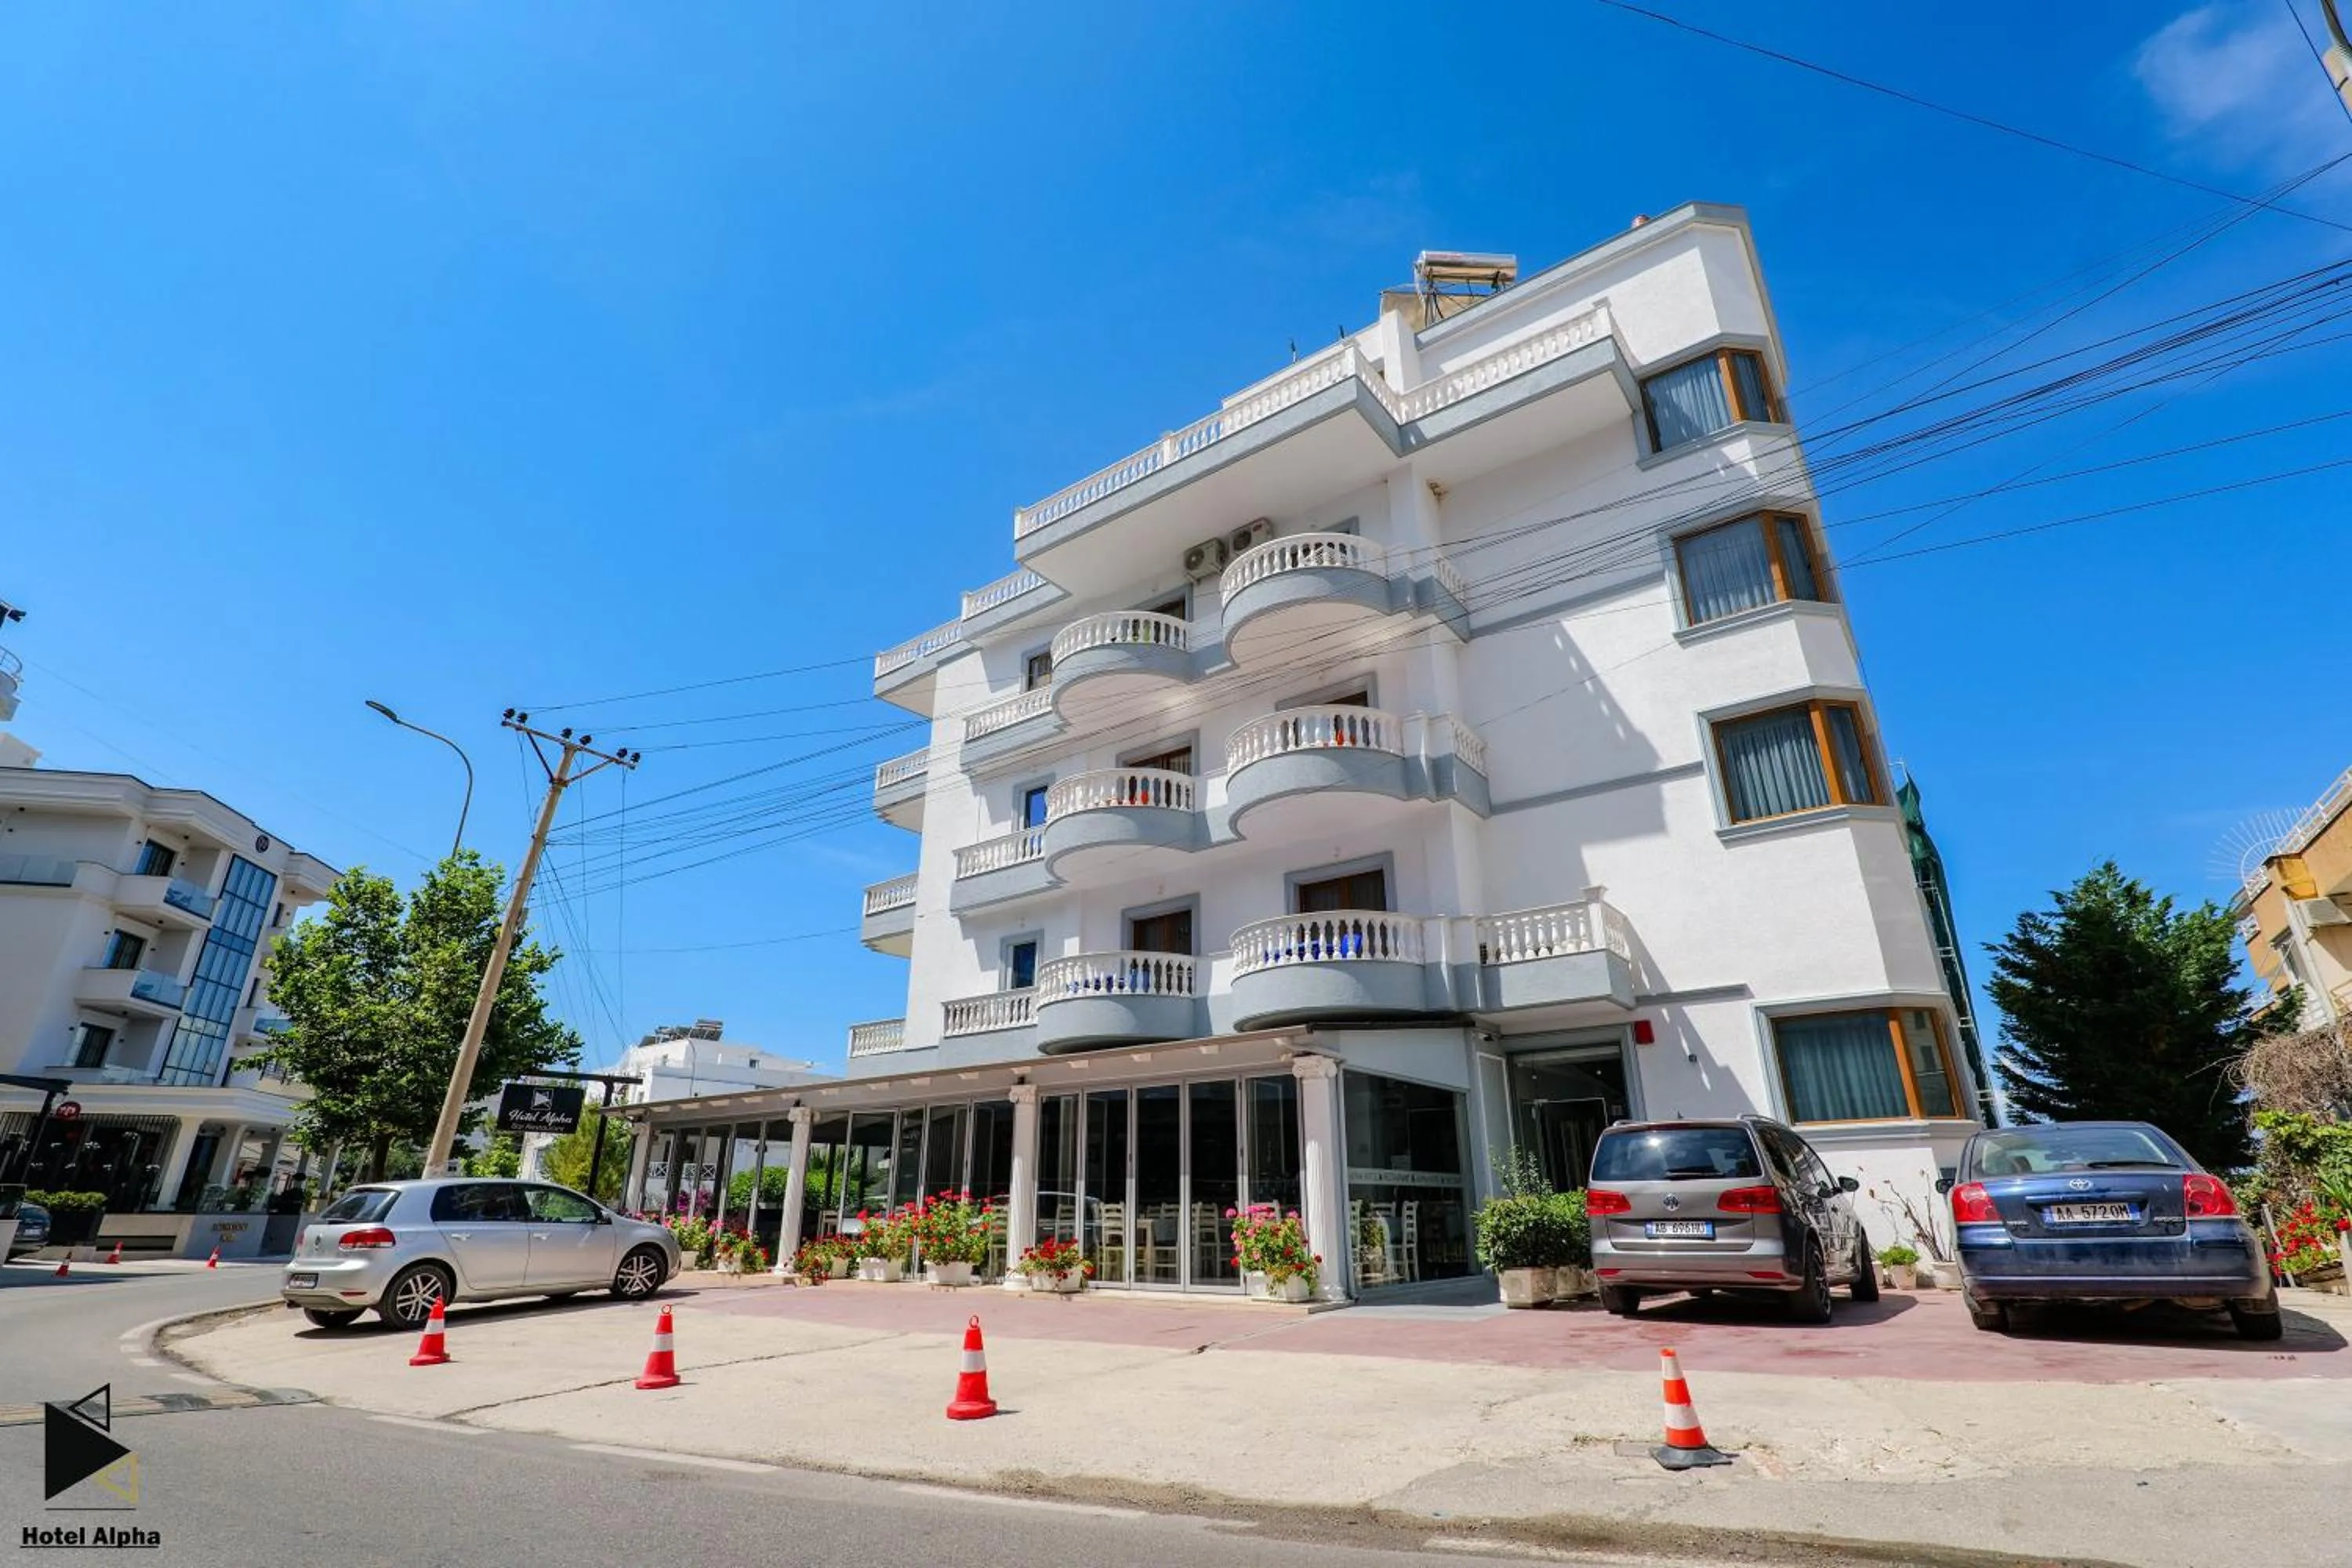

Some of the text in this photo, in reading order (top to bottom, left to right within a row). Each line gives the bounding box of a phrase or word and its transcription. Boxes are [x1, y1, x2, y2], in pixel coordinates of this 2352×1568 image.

[508, 1109, 573, 1127] Hotel Alpha
[2056, 1207, 2074, 1221] AA
